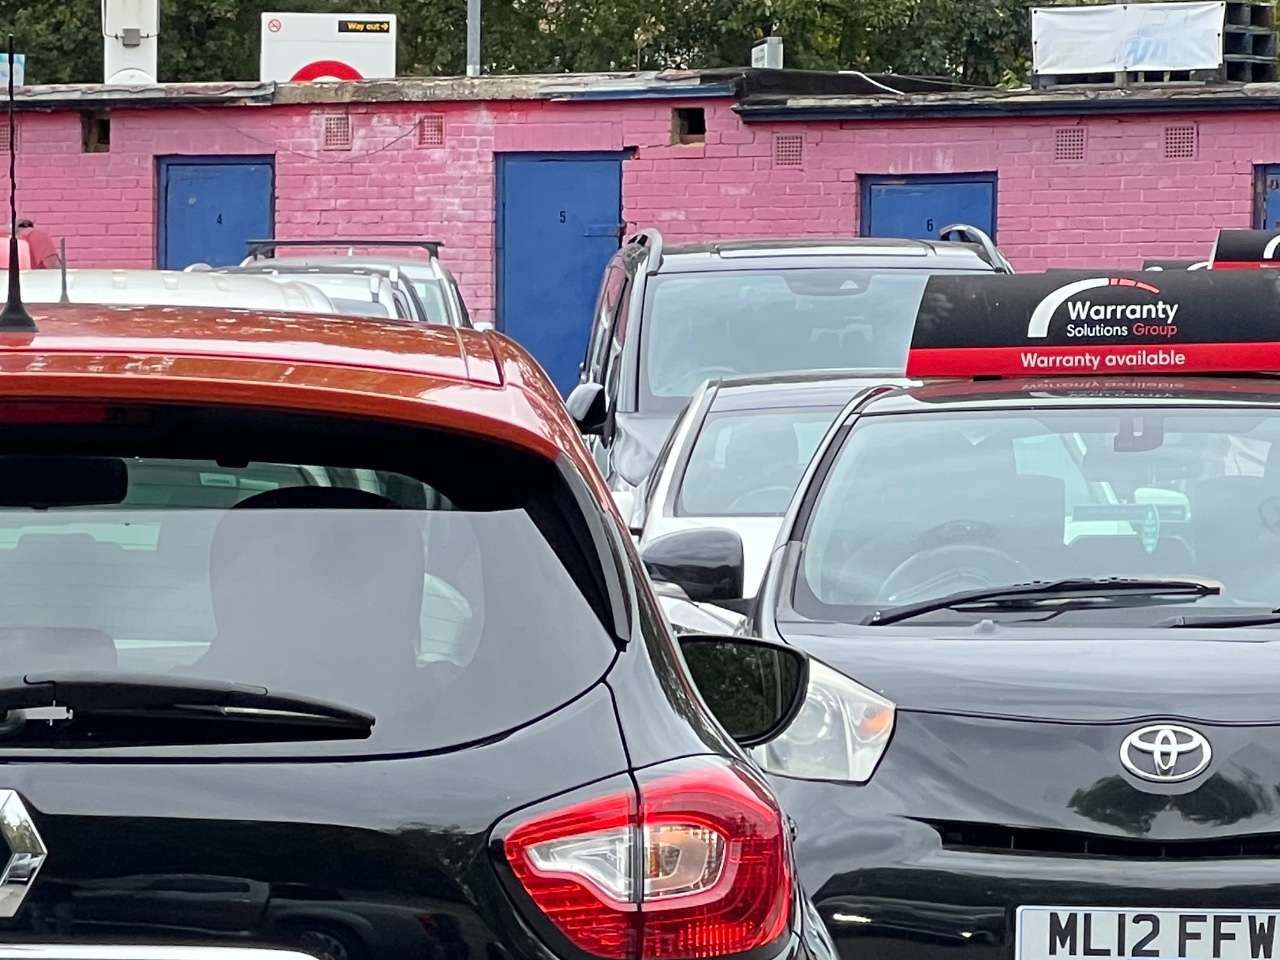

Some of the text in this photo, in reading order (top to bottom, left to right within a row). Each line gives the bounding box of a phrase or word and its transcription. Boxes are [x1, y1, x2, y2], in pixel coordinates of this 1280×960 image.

[347, 22, 381, 32] Way out
[216, 213, 222, 225] 4
[559, 210, 566, 224] 5
[926, 218, 933, 232] 6
[1067, 300, 1179, 324] Warranty
[1067, 323, 1177, 337] Solutions Group
[1020, 349, 1186, 370] Warranty available
[1048, 911, 1277, 959] ML12 FFW
